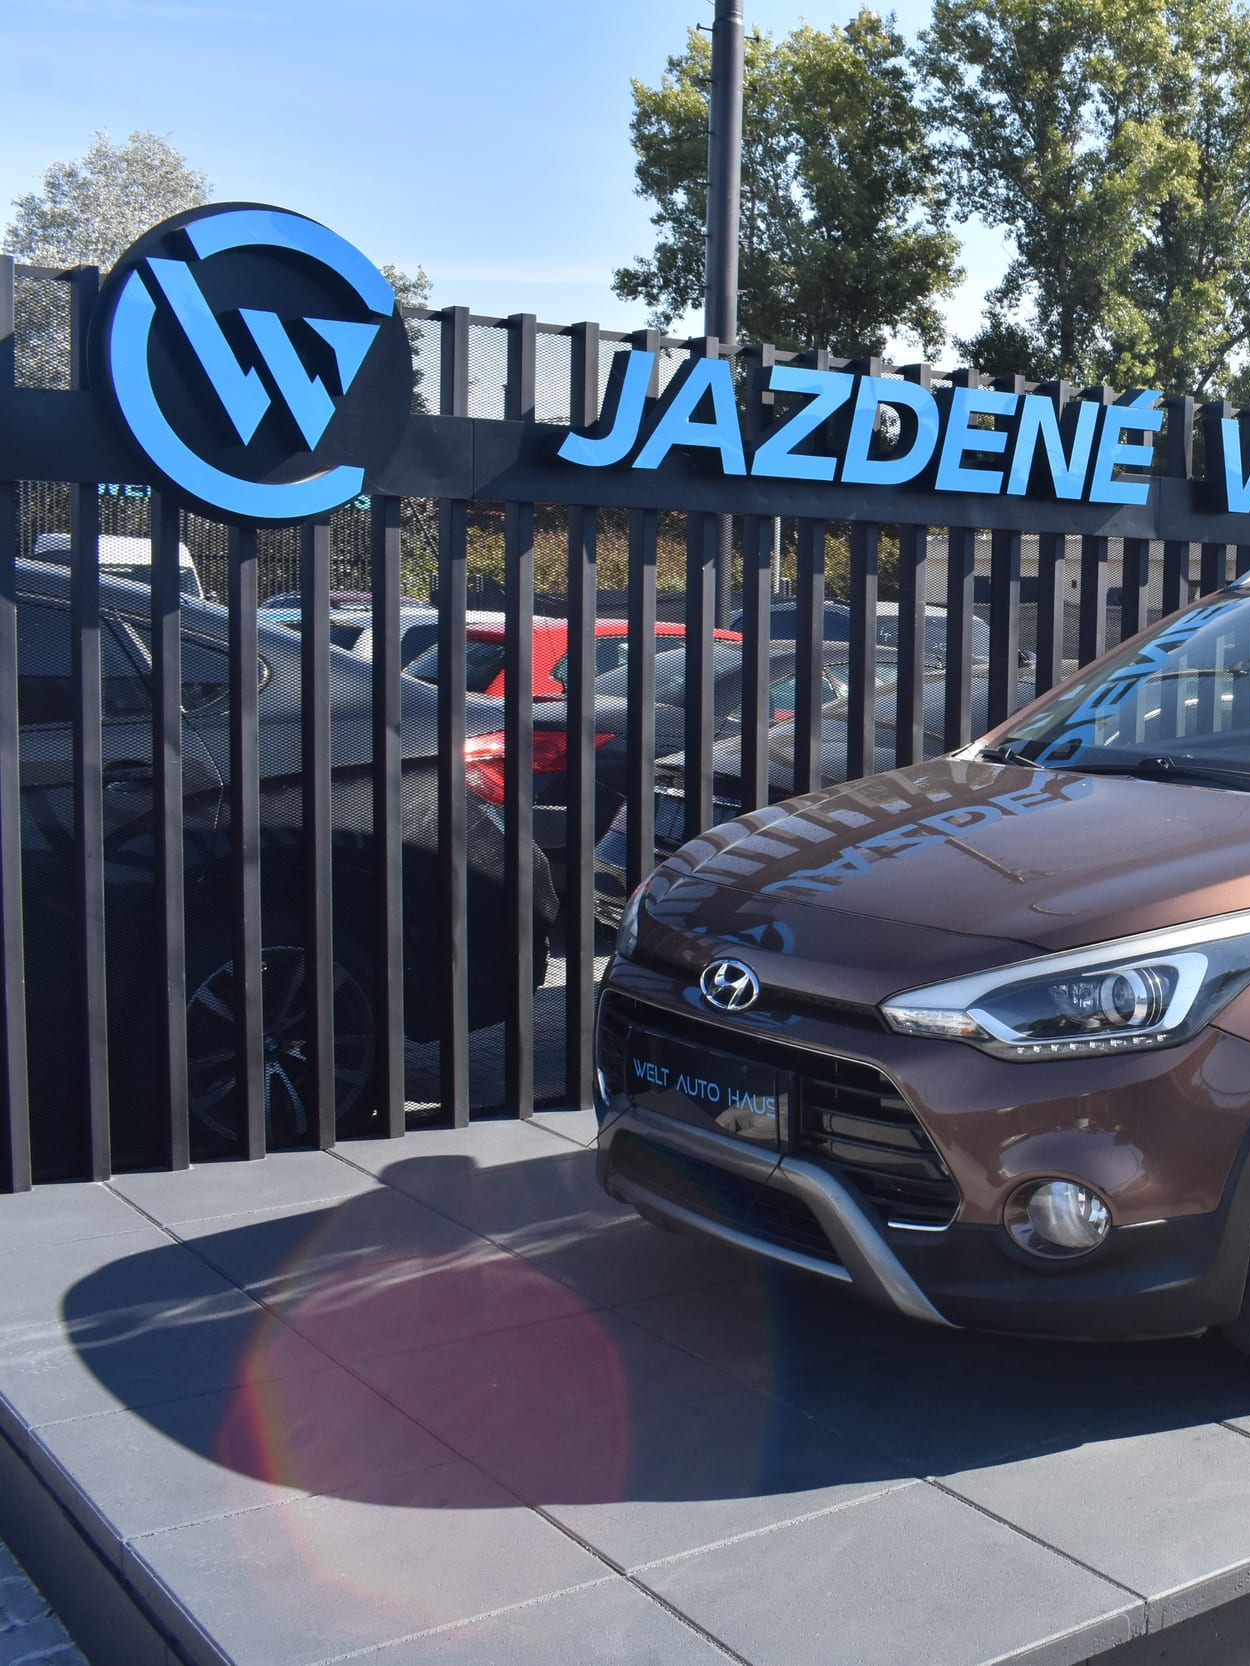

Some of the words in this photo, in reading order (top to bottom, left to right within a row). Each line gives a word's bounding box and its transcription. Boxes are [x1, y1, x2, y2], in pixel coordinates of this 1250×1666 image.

[557, 349, 1164, 506] JAZDENÉ
[633, 1057, 670, 1087] WELT
[676, 1073, 720, 1102] AUTO
[728, 1087, 776, 1119] HAUS
